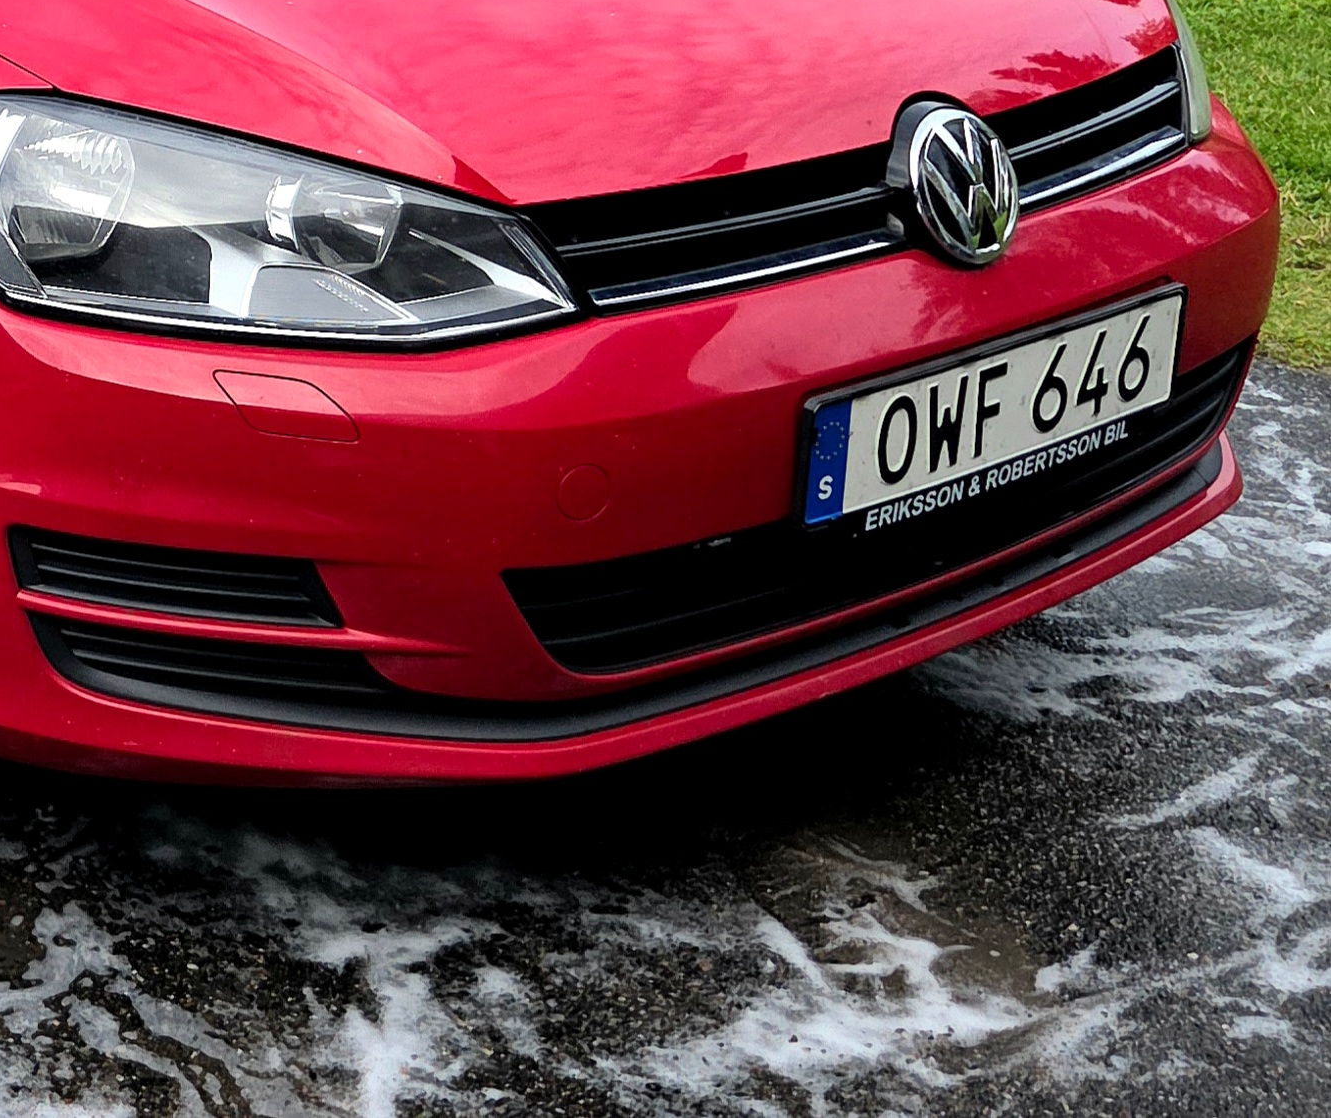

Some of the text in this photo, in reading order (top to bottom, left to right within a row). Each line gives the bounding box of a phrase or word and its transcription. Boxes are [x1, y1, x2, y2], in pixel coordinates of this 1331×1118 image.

[877, 314, 1151, 484] OWF 646
[818, 475, 833, 500] S
[865, 421, 1129, 531] ERIKSSON & ROBERTSSON BIL
